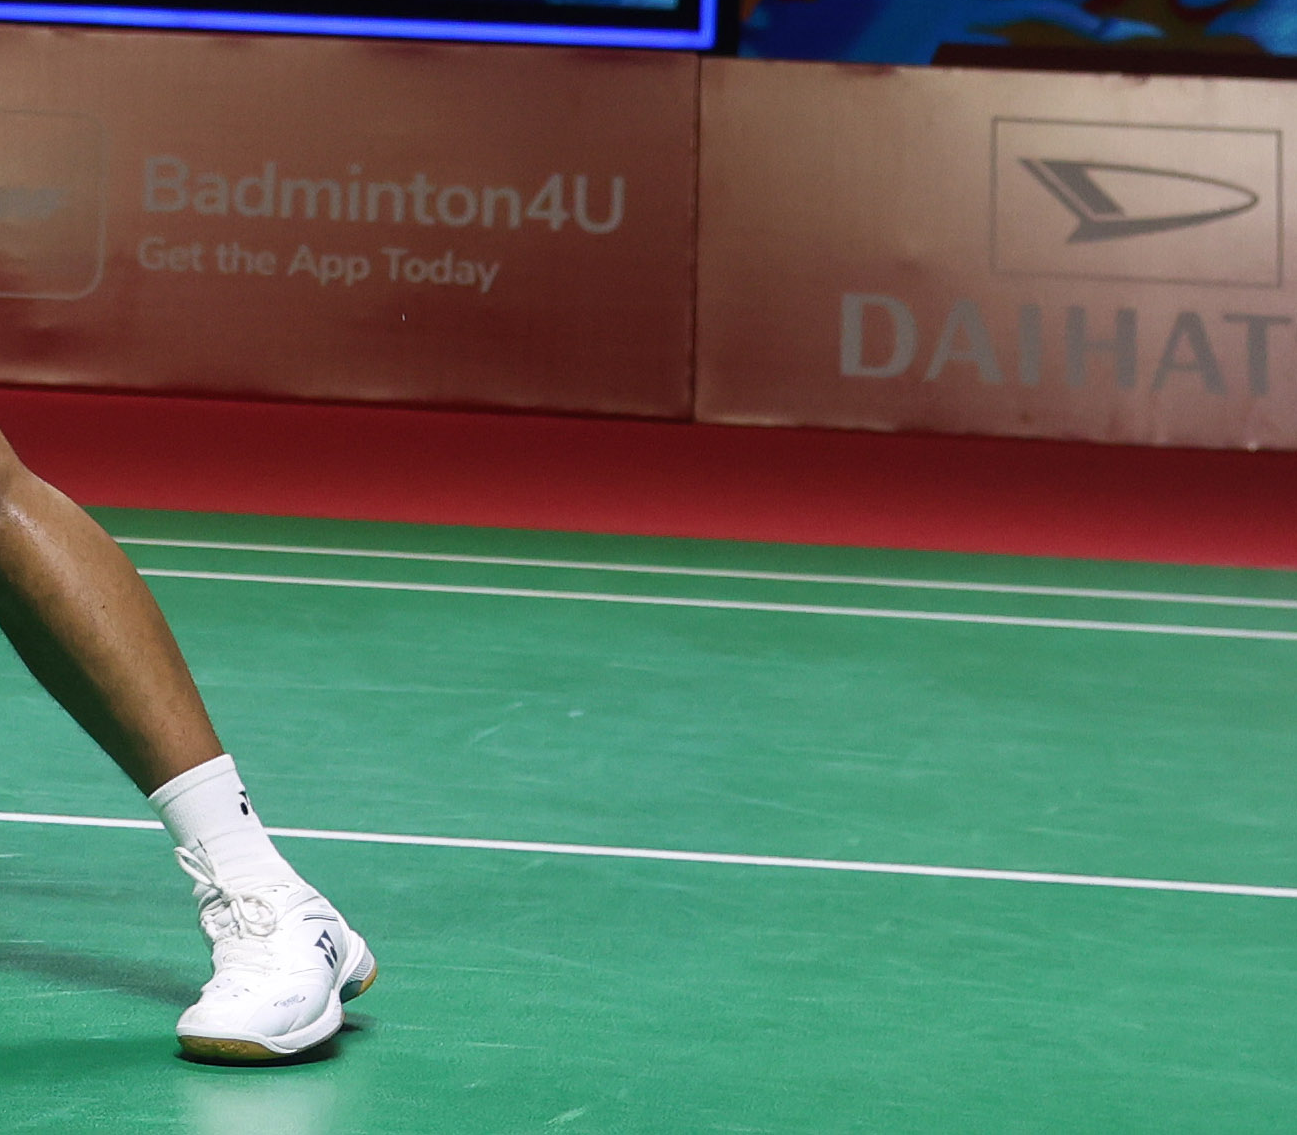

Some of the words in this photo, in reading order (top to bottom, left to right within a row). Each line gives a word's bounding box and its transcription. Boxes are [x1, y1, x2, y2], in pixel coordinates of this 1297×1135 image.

[140, 156, 626, 235] Badminton4U
[137, 236, 203, 272] Get
[217, 242, 277, 276] the
[287, 245, 372, 286] App
[382, 247, 501, 293] Today
[840, 292, 1294, 408] DAIHAT
